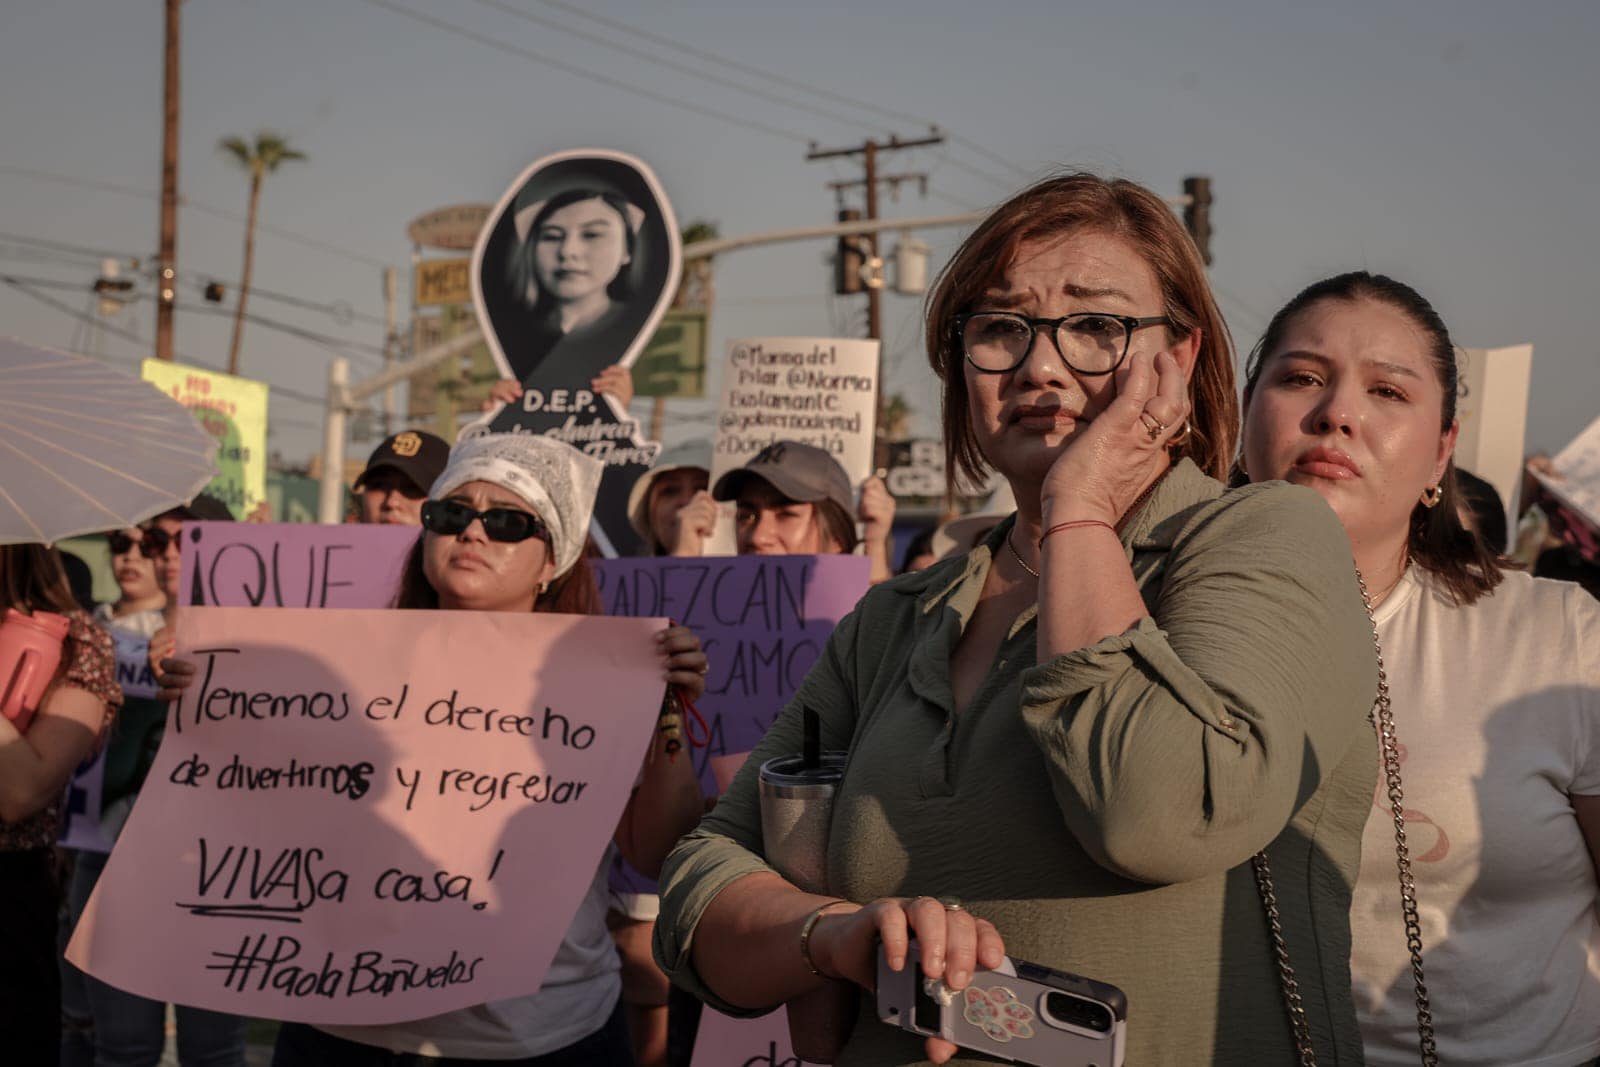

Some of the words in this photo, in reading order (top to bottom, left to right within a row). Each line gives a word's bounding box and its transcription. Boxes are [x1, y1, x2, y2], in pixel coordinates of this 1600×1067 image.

[806, 345, 836, 365] del
[786, 369, 872, 391] @Norma
[523, 389, 598, 413] D.E.P.
[365, 684, 409, 721] el
[425, 689, 596, 751] derecho
[169, 753, 210, 787] de
[216, 754, 375, 801] divertirnos
[396, 767, 421, 811] y
[439, 768, 588, 812] regresar
